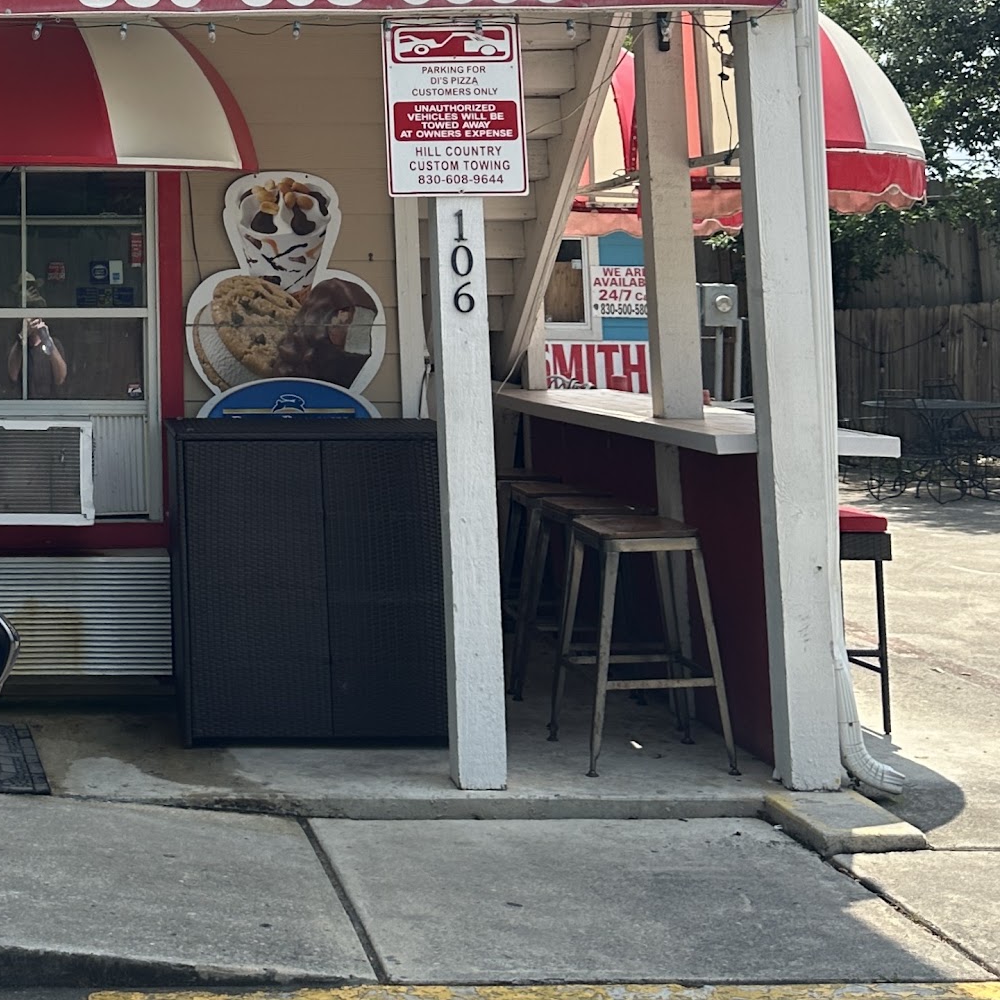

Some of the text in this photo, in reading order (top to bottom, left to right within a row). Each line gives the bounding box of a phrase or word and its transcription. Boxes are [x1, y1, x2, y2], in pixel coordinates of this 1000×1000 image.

[421, 65, 487, 74] PARKING FOR
[430, 76, 479, 85] DI'S PIZZA
[411, 87, 498, 97] CUSTOMERS ONLY
[414, 104, 496, 112] UNAUTHORIZED
[407, 112, 505, 121] VEHICLES WILL BE
[420, 121, 491, 129] TOWED AWAY
[399, 129, 514, 138] AT OWNERS EXPENSE
[415, 146, 502, 157] HILL COUNTRY
[409, 160, 511, 172] CUSTOM TOWING
[418, 174, 504, 185] 830-608-9644
[451, 209, 475, 313] 106
[602, 267, 621, 277] WE
[598, 289, 632, 302] 24/7
